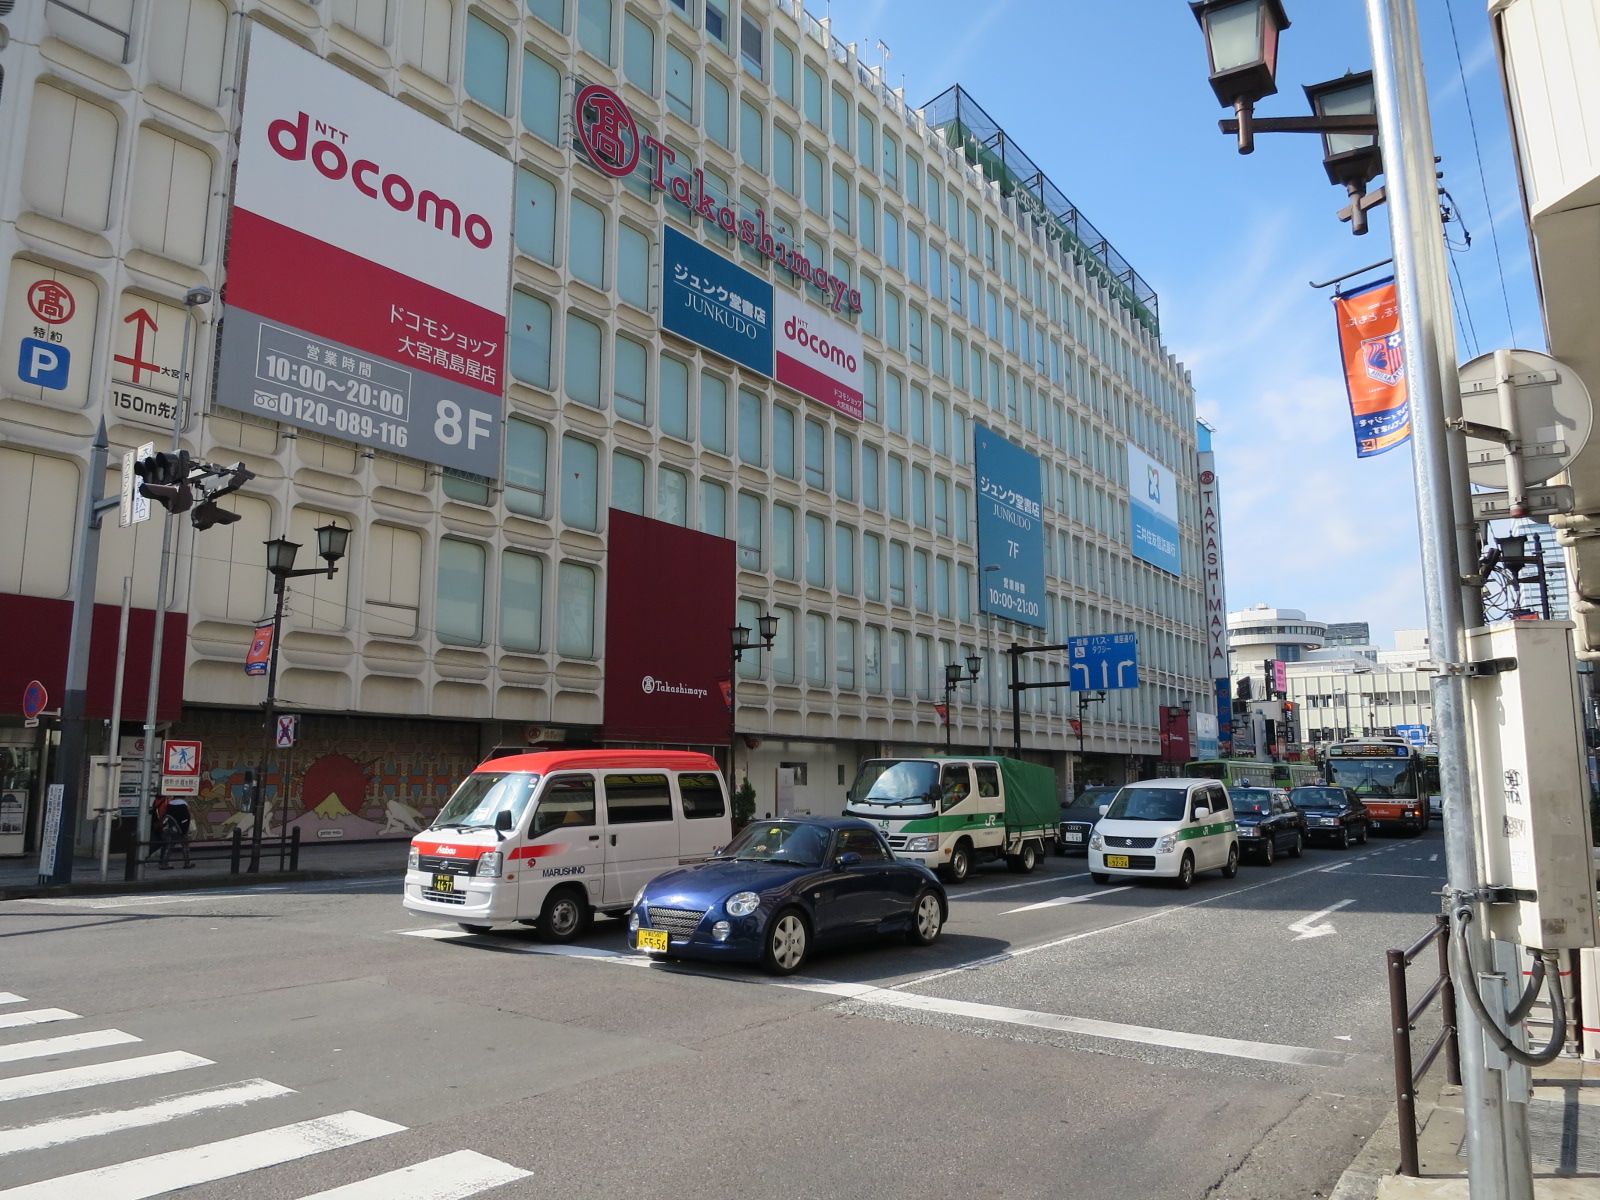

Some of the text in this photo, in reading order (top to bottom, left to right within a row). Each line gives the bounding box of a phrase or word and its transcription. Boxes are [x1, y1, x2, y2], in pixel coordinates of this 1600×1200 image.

[315, 119, 349, 144] NTT
[267, 111, 493, 249] docomo
[643, 134, 863, 314] Takashimaya
[673, 262, 766, 325] ジュンク堂書店
[389, 303, 498, 357] ドコモショップ
[684, 292, 757, 340] JUNKUDO
[32, 326, 63, 343] 特約
[784, 315, 857, 373] docomo
[30, 346, 59, 378] P
[306, 344, 372, 378] 営業時間
[278, 392, 408, 448] 0120-089-116
[433, 399, 493, 450] 8F
[980, 476, 1040, 518] ジュンク堂書店
[992, 503, 1031, 532] JUNKUDO
[1007, 540, 1020, 559] 7F
[1203, 491, 1224, 659] TAKASHIMAYA
[655, 680, 708, 699] Takashimaya
[878, 820, 890, 830] JR
[985, 815, 996, 827] JR
[542, 866, 585, 878] MARUSHINO
[644, 937, 666, 951] 55-56
